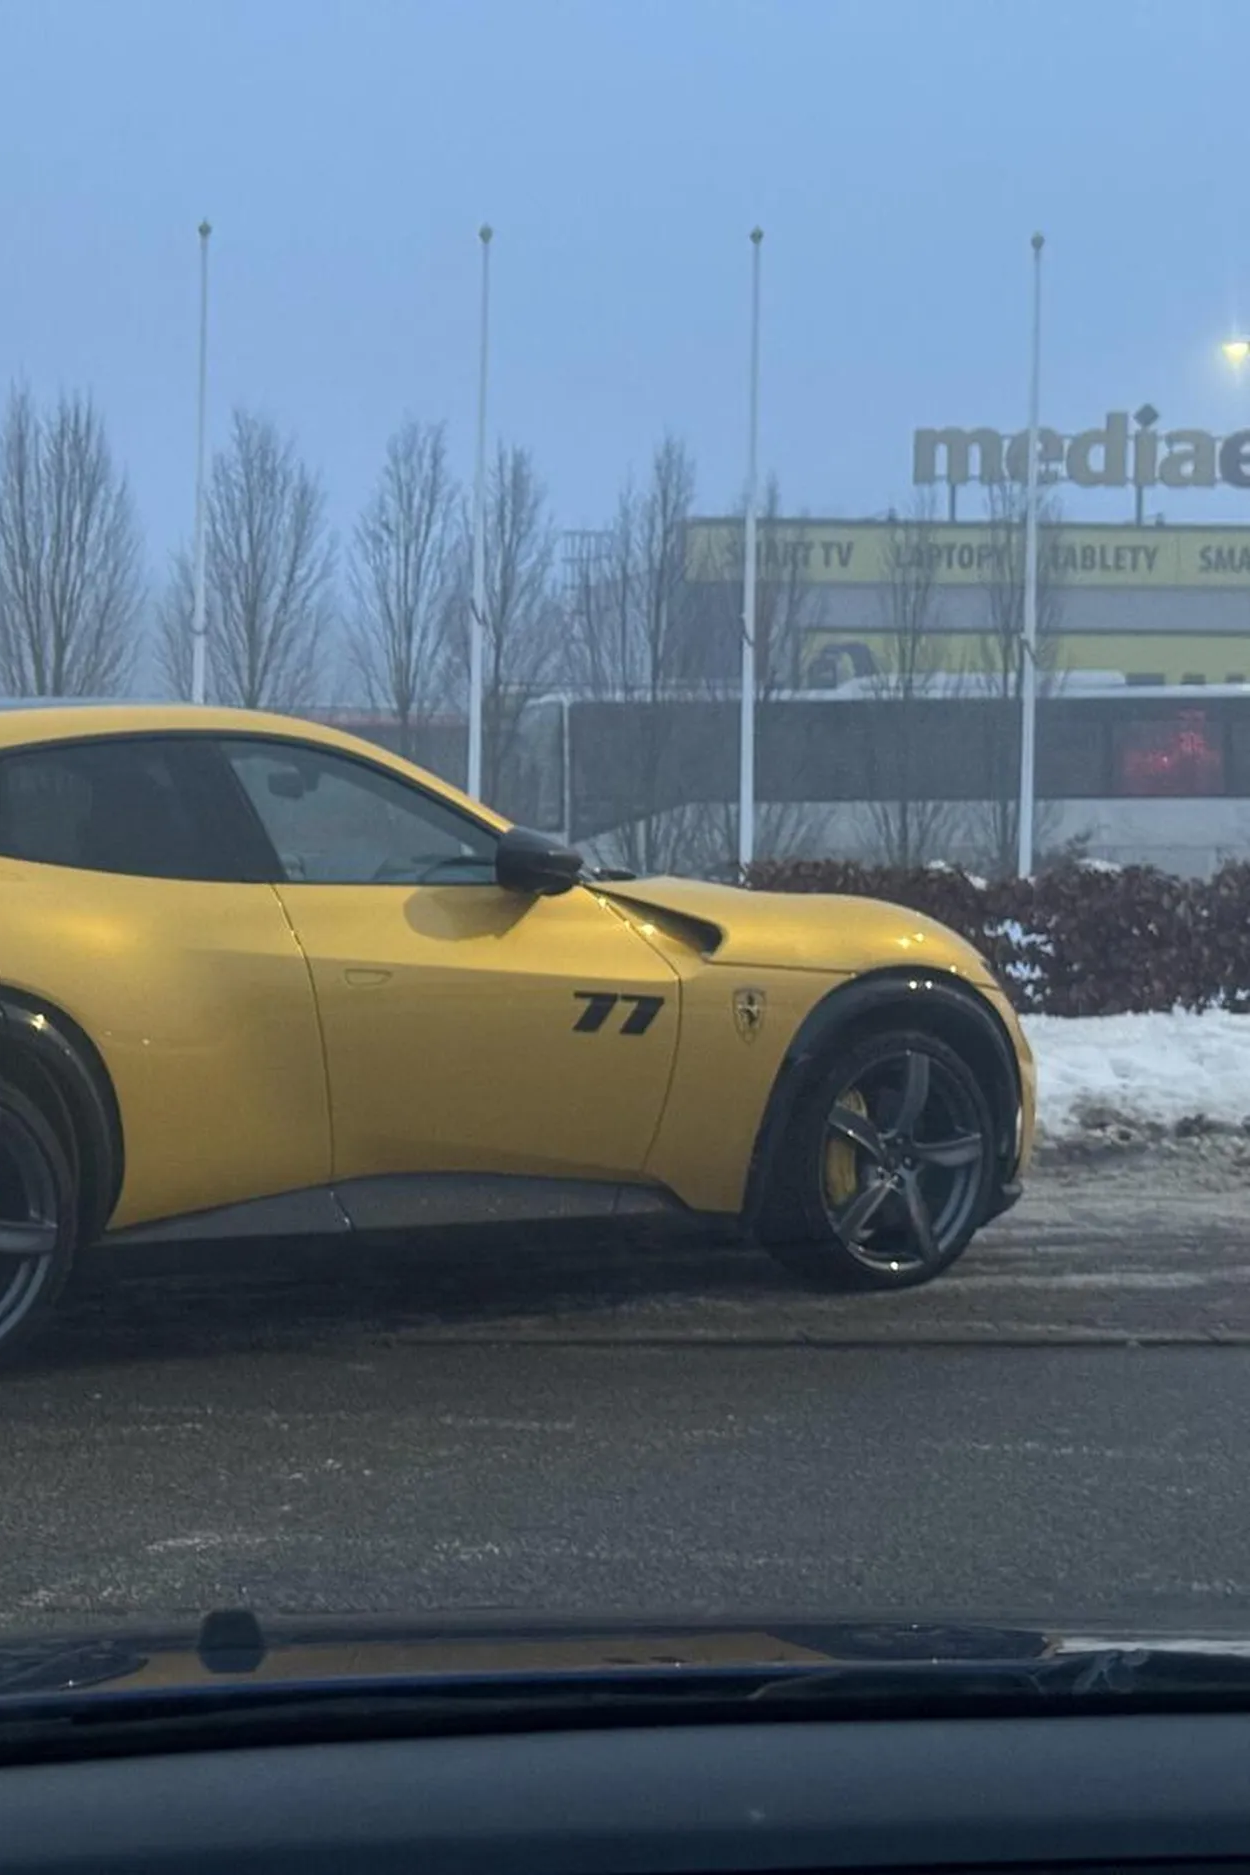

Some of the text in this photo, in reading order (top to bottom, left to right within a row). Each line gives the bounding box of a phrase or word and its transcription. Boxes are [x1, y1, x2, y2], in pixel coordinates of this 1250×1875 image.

[913, 403, 1250, 488] mediae
[821, 541, 854, 568] TV
[572, 991, 664, 1035] 77
